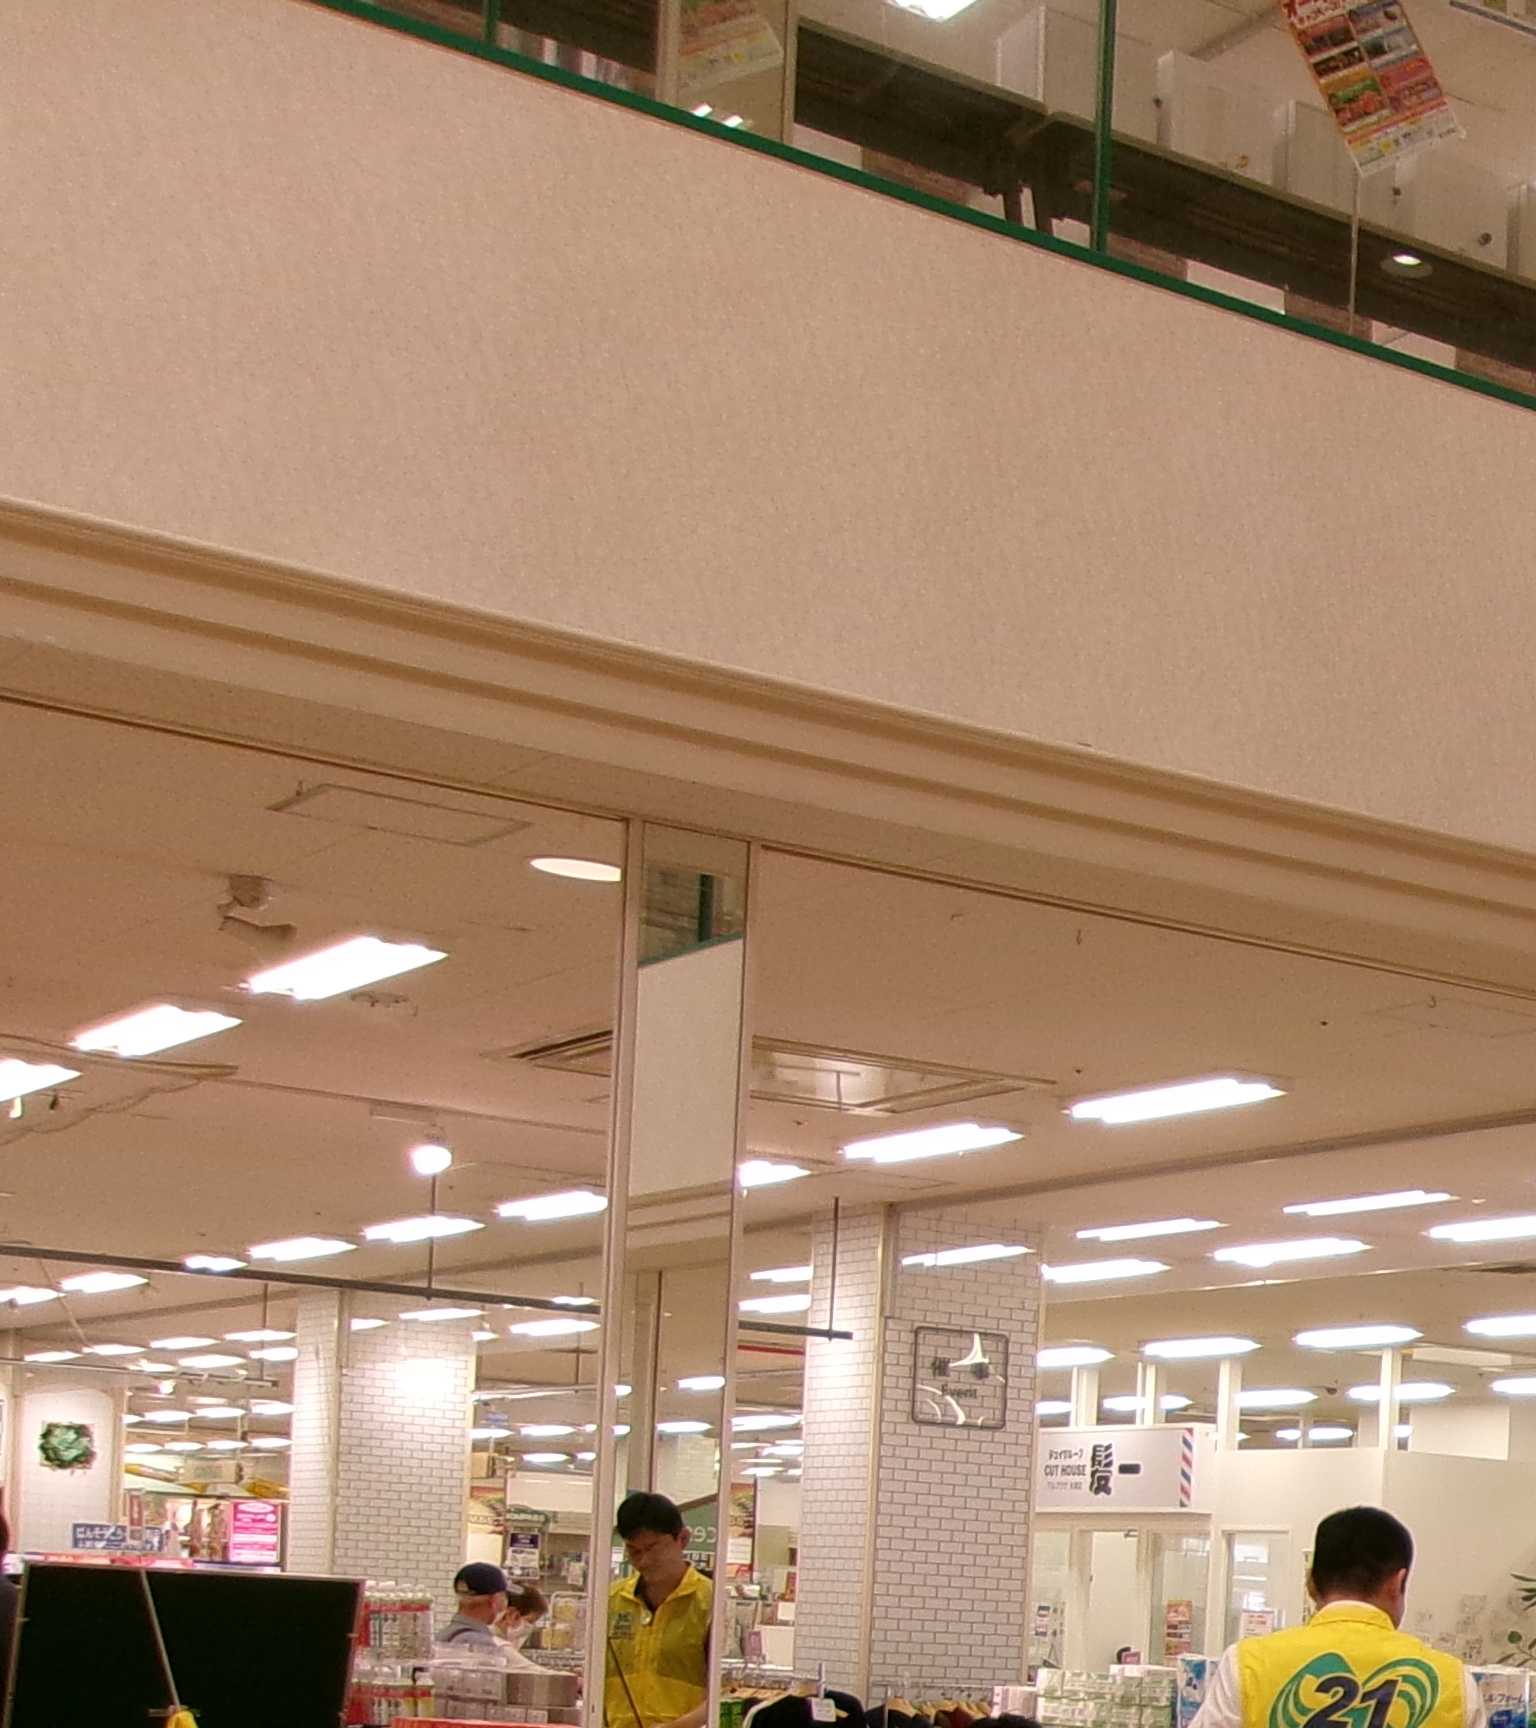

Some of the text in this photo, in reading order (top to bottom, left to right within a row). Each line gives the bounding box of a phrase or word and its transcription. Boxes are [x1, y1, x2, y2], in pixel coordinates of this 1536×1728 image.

[941, 1383, 978, 1400] Event
[1044, 1463, 1087, 1477] CUT HOUSE
